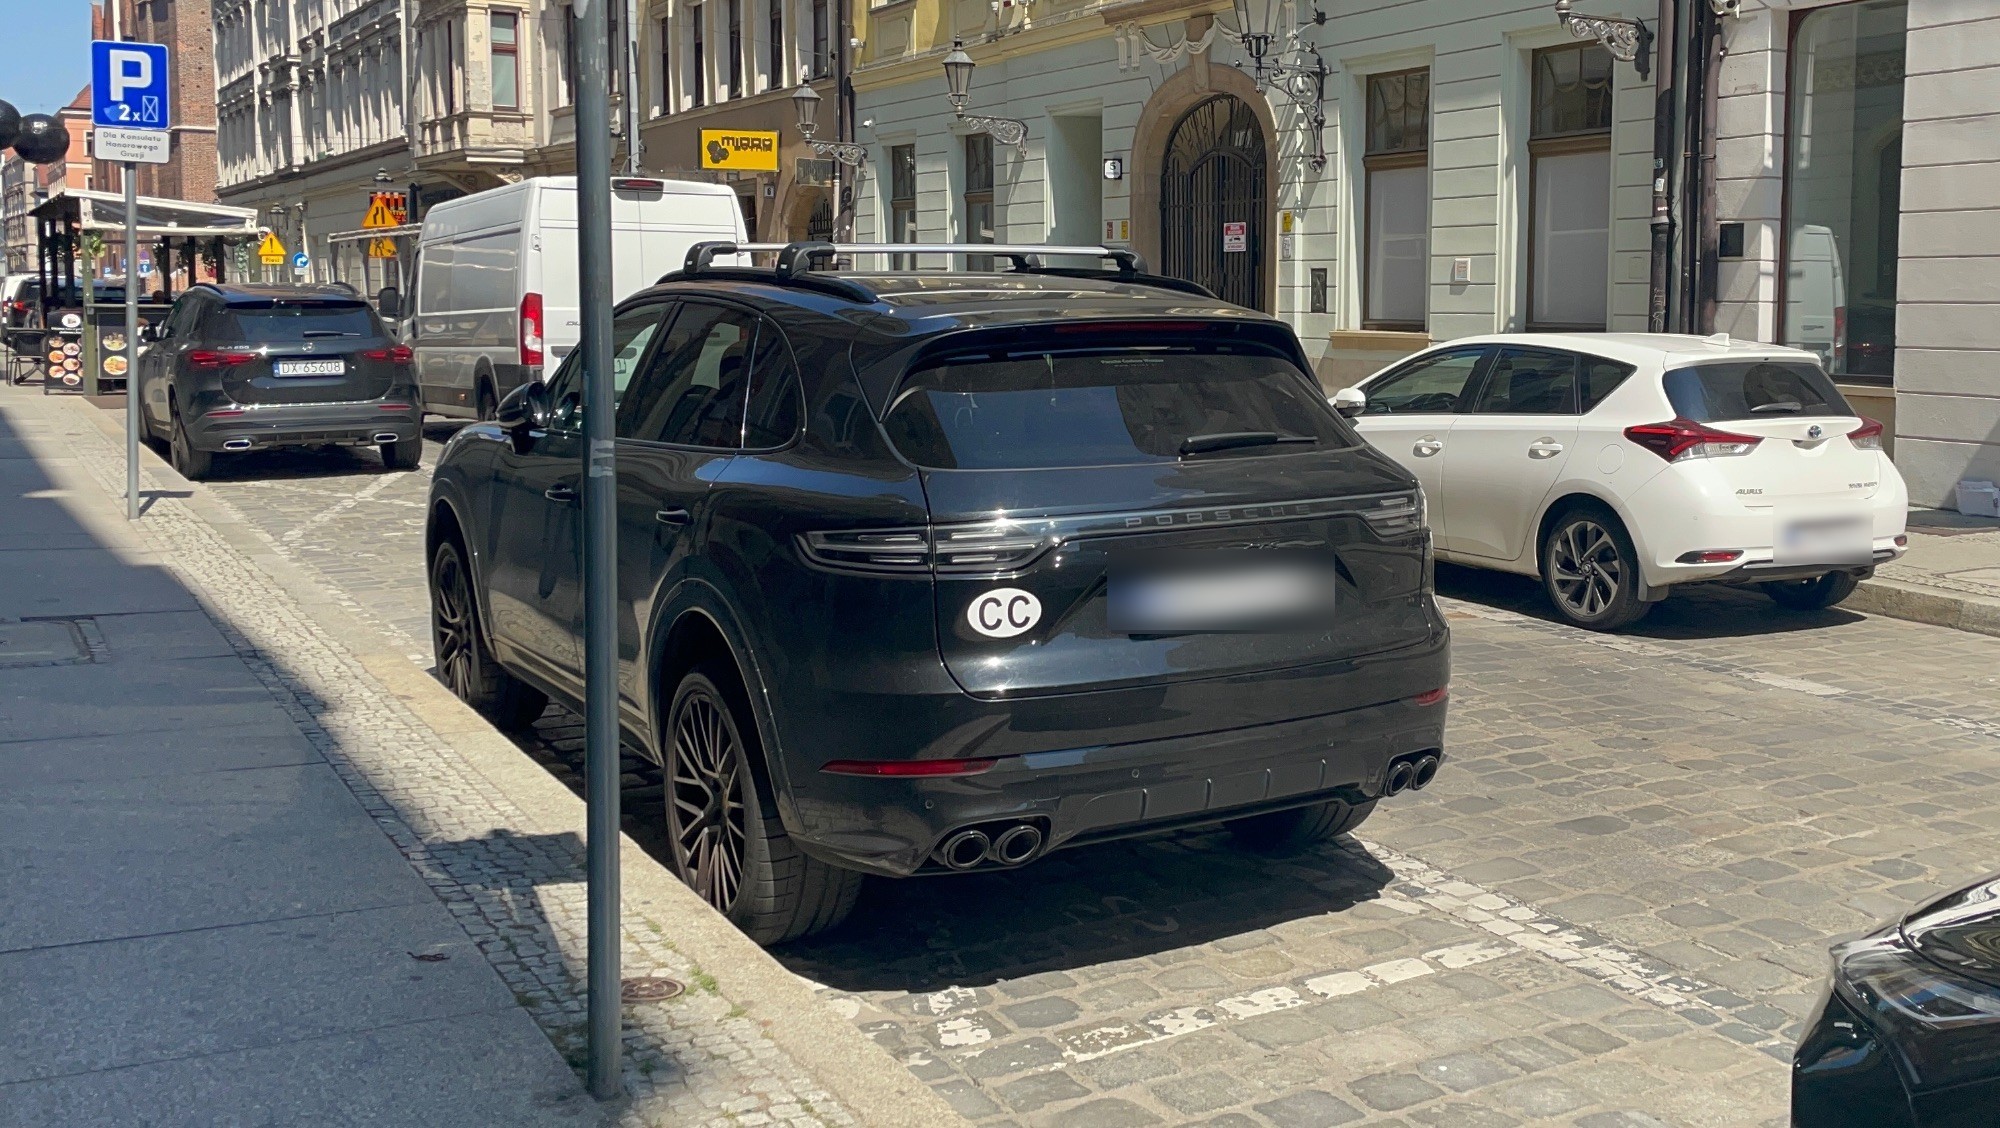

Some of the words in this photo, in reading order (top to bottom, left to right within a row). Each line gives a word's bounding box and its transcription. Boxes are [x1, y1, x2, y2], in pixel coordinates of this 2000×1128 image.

[110, 49, 151, 101] P
[103, 131, 117, 139] Dla
[120, 133, 161, 141] Konsulatu
[105, 140, 159, 151] Honorowego
[1110, 162, 1117, 171] 5
[282, 362, 298, 373] DX
[304, 361, 341, 373] 65608
[1125, 505, 1312, 528] PORSCHE
[978, 595, 1031, 631] CC
